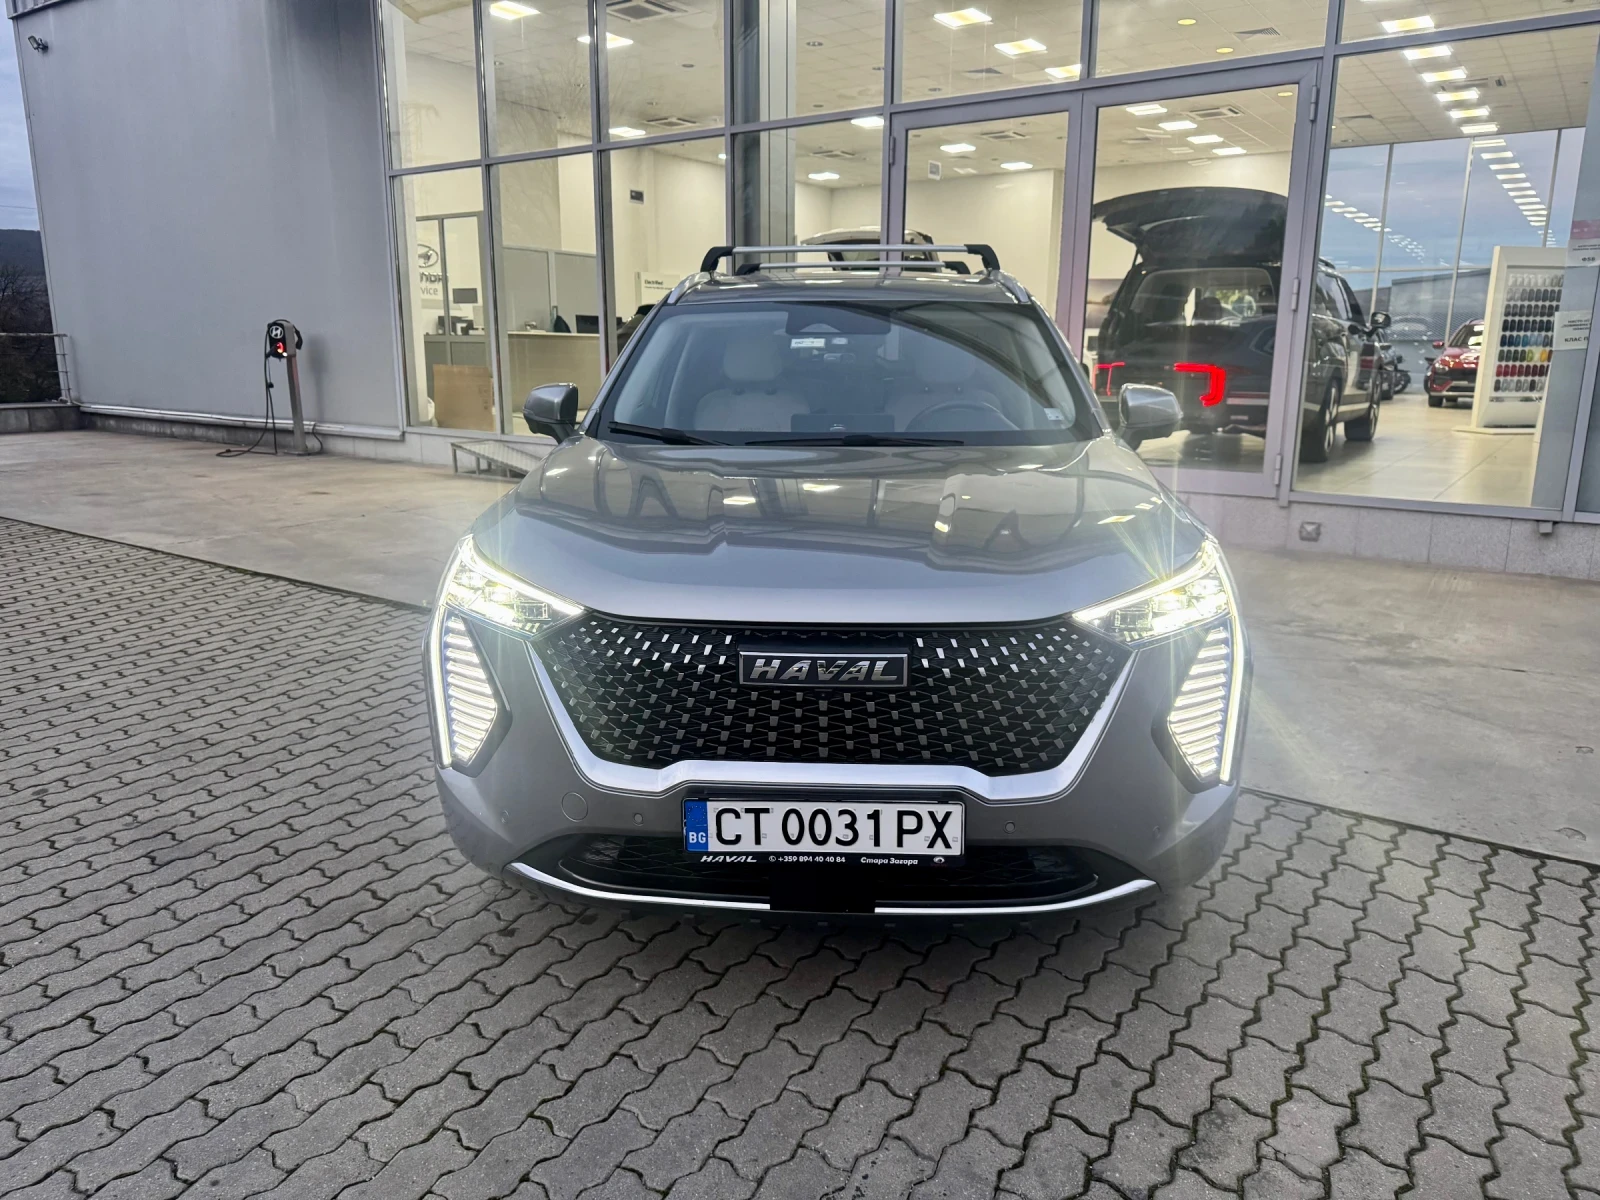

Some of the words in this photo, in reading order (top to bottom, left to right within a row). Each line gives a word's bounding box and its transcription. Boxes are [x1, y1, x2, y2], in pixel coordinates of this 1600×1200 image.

[420, 285, 438, 296] vice
[749, 658, 898, 681] HAVAL
[715, 807, 771, 846] CT
[781, 808, 881, 847] 0031
[896, 809, 953, 850] PX
[688, 831, 707, 844] BG
[700, 855, 758, 863] HAVAL
[777, 855, 798, 863] +359
[799, 855, 813, 863] 894
